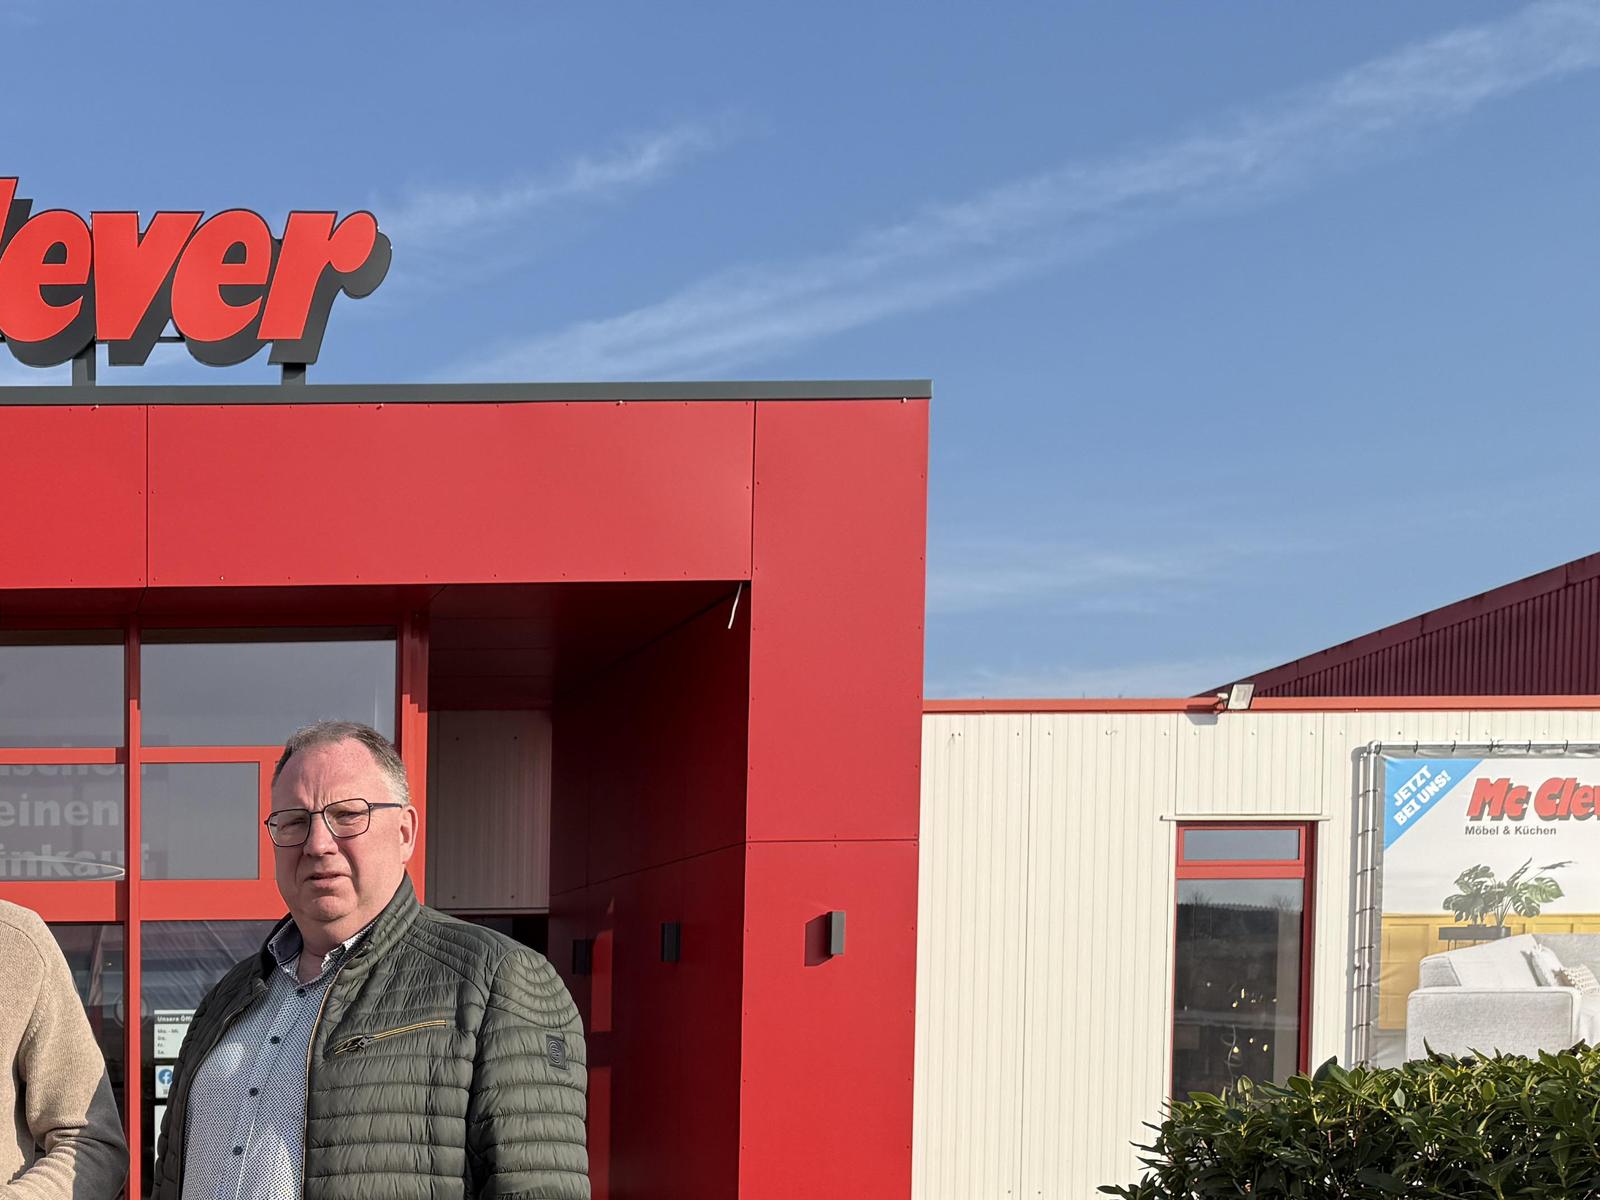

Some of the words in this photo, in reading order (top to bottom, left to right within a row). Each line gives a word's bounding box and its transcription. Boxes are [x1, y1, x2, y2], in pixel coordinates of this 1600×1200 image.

[1393, 764, 1432, 807] JETZT
[1393, 798, 1421, 826] BEI
[1416, 769, 1452, 804] UNS!
[1466, 777, 1532, 821] Mc
[1465, 825, 1499, 836] Möbel
[1503, 826, 1511, 836] &
[1515, 825, 1557, 836] Küchen
